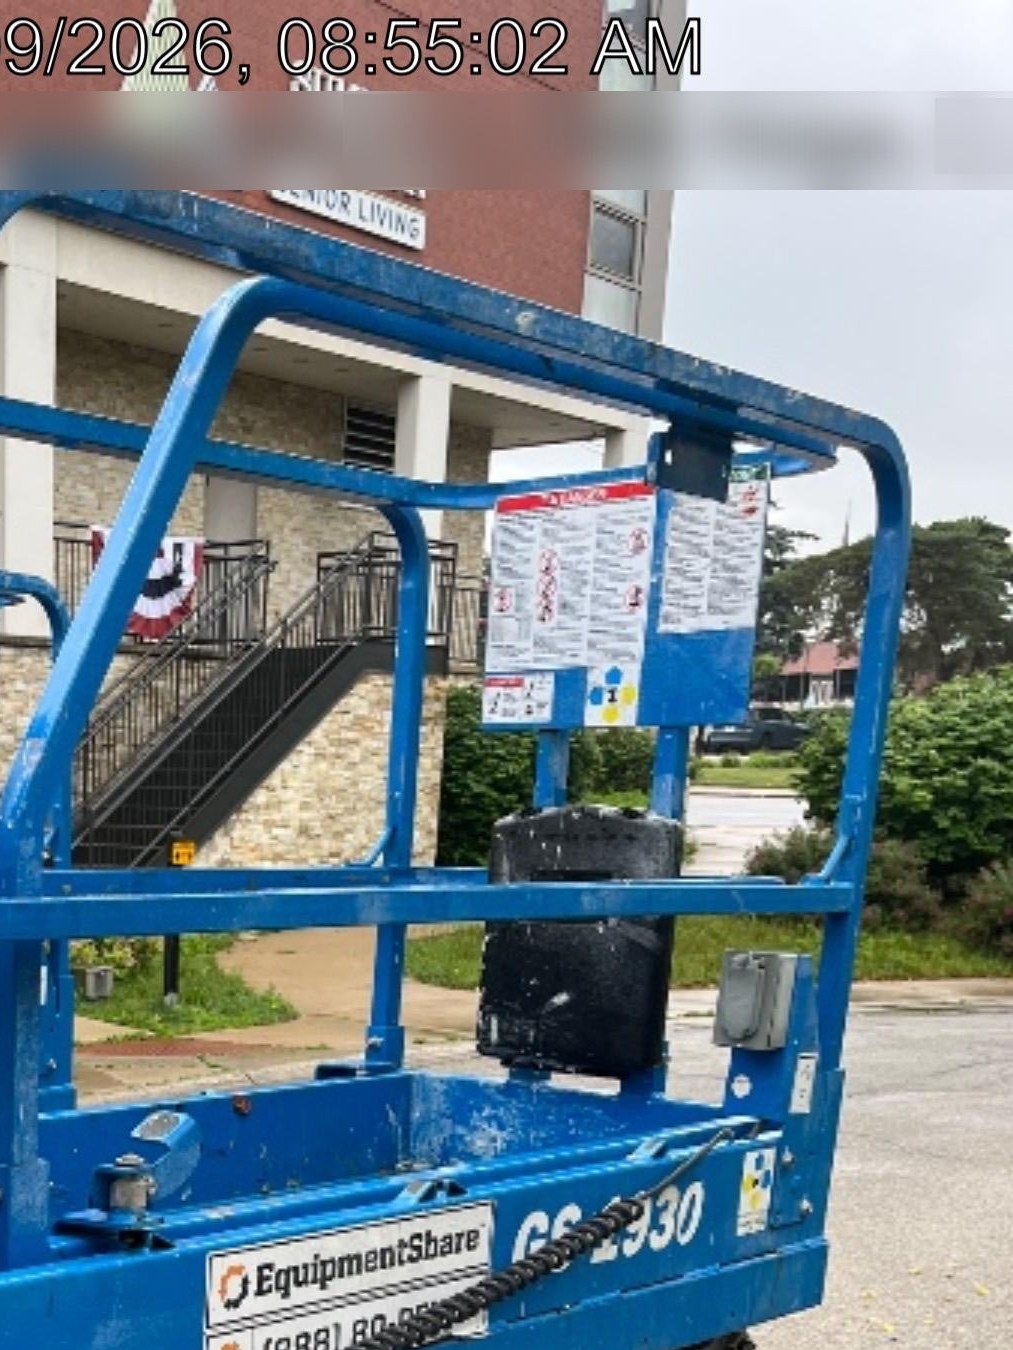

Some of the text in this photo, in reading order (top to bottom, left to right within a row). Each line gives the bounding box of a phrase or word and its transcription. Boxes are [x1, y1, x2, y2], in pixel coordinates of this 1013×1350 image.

[277, 190, 421, 241] ENIOR LIVING
[254, 1229, 481, 1299] EquipmentShare
